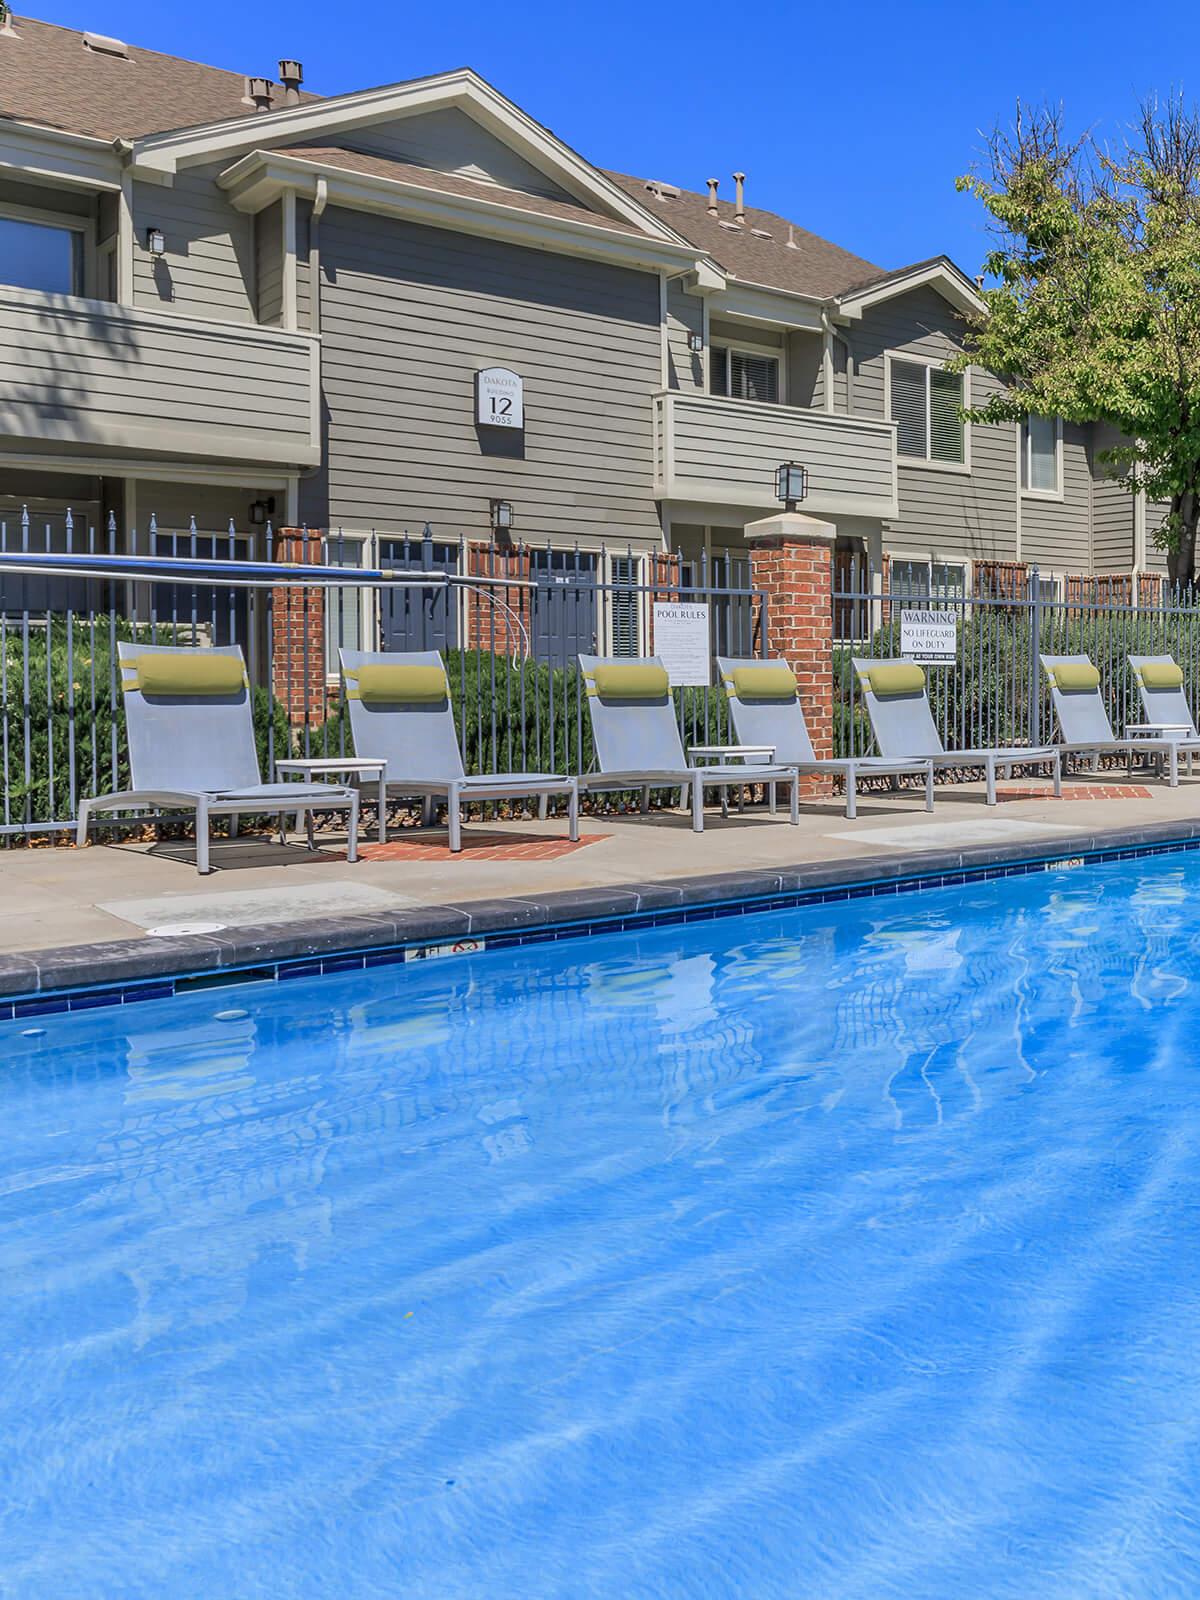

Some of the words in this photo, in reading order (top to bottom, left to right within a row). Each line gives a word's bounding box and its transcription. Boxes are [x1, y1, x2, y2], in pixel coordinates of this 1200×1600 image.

[484, 376, 517, 387] DAKOTA
[489, 396, 512, 416] 12
[490, 415, 512, 425] 9055
[657, 610, 679, 618] POOL
[680, 611, 706, 619] RULES
[903, 611, 955, 624] WARNING
[903, 629, 914, 637] NO
[916, 629, 954, 638] LIFEGUARD
[912, 640, 923, 648] ON
[925, 640, 945, 648] DUTY
